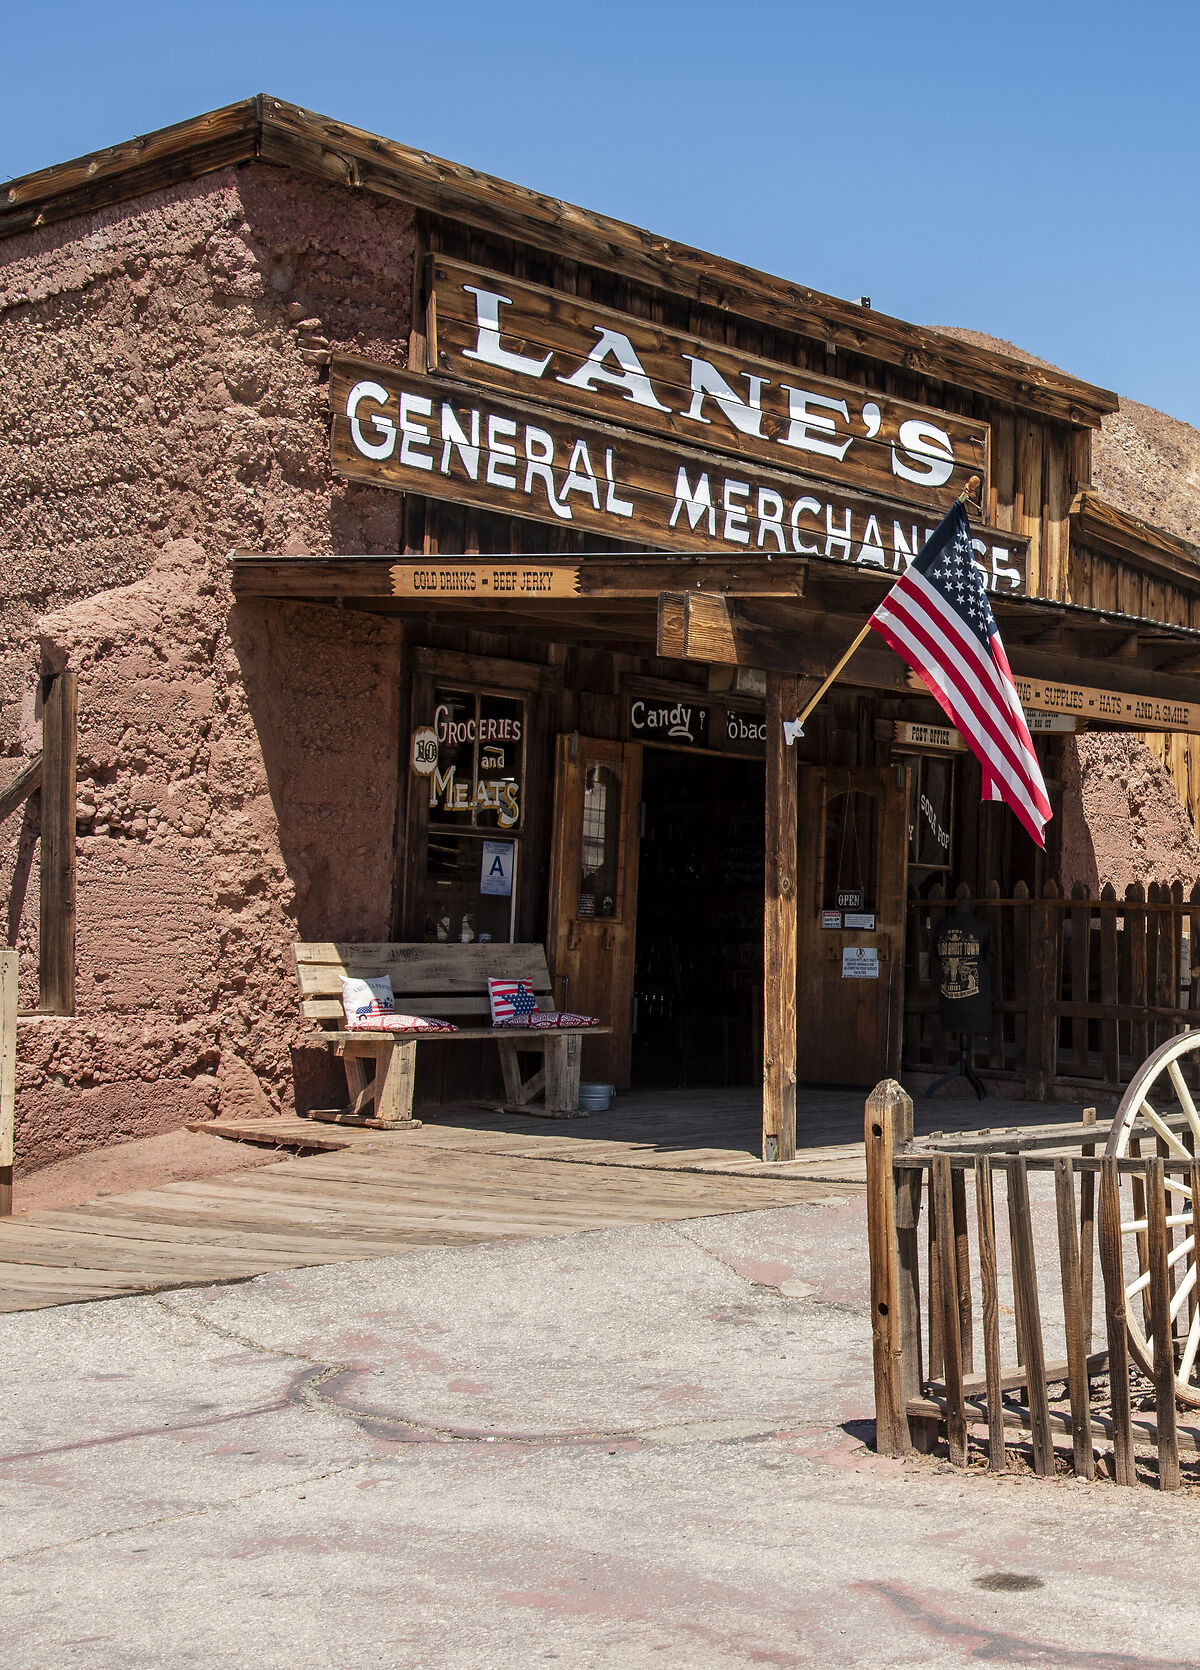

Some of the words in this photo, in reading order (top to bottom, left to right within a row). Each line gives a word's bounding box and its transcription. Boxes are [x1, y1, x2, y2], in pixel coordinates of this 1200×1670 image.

[462, 284, 955, 488] LANE'S
[346, 380, 634, 520] GENERAL
[668, 466, 1021, 591] MERCHANSE
[413, 571, 437, 590] COLD
[440, 571, 477, 590] DRINKS
[493, 571, 517, 591] BEEF
[520, 571, 553, 591] JERKY
[631, 701, 694, 742] Candy
[1044, 687, 1083, 709] SUPPLIES
[1099, 694, 1122, 715] HATS
[1134, 702, 1153, 719] AND
[1154, 704, 1161, 720] A
[1162, 706, 1189, 725] SMILE
[434, 705, 521, 744] GROCERIES
[911, 726, 927, 741] POST
[929, 728, 950, 745] OFFICE
[416, 740, 437, 763] 10
[481, 745, 505, 769] and
[429, 765, 520, 828] MEATS
[920, 794, 936, 835] SODA
[937, 824, 950, 849] POP
[488, 855, 505, 877] A
[838, 894, 861, 906] OPEN
[964, 942, 980, 956] TOWN
